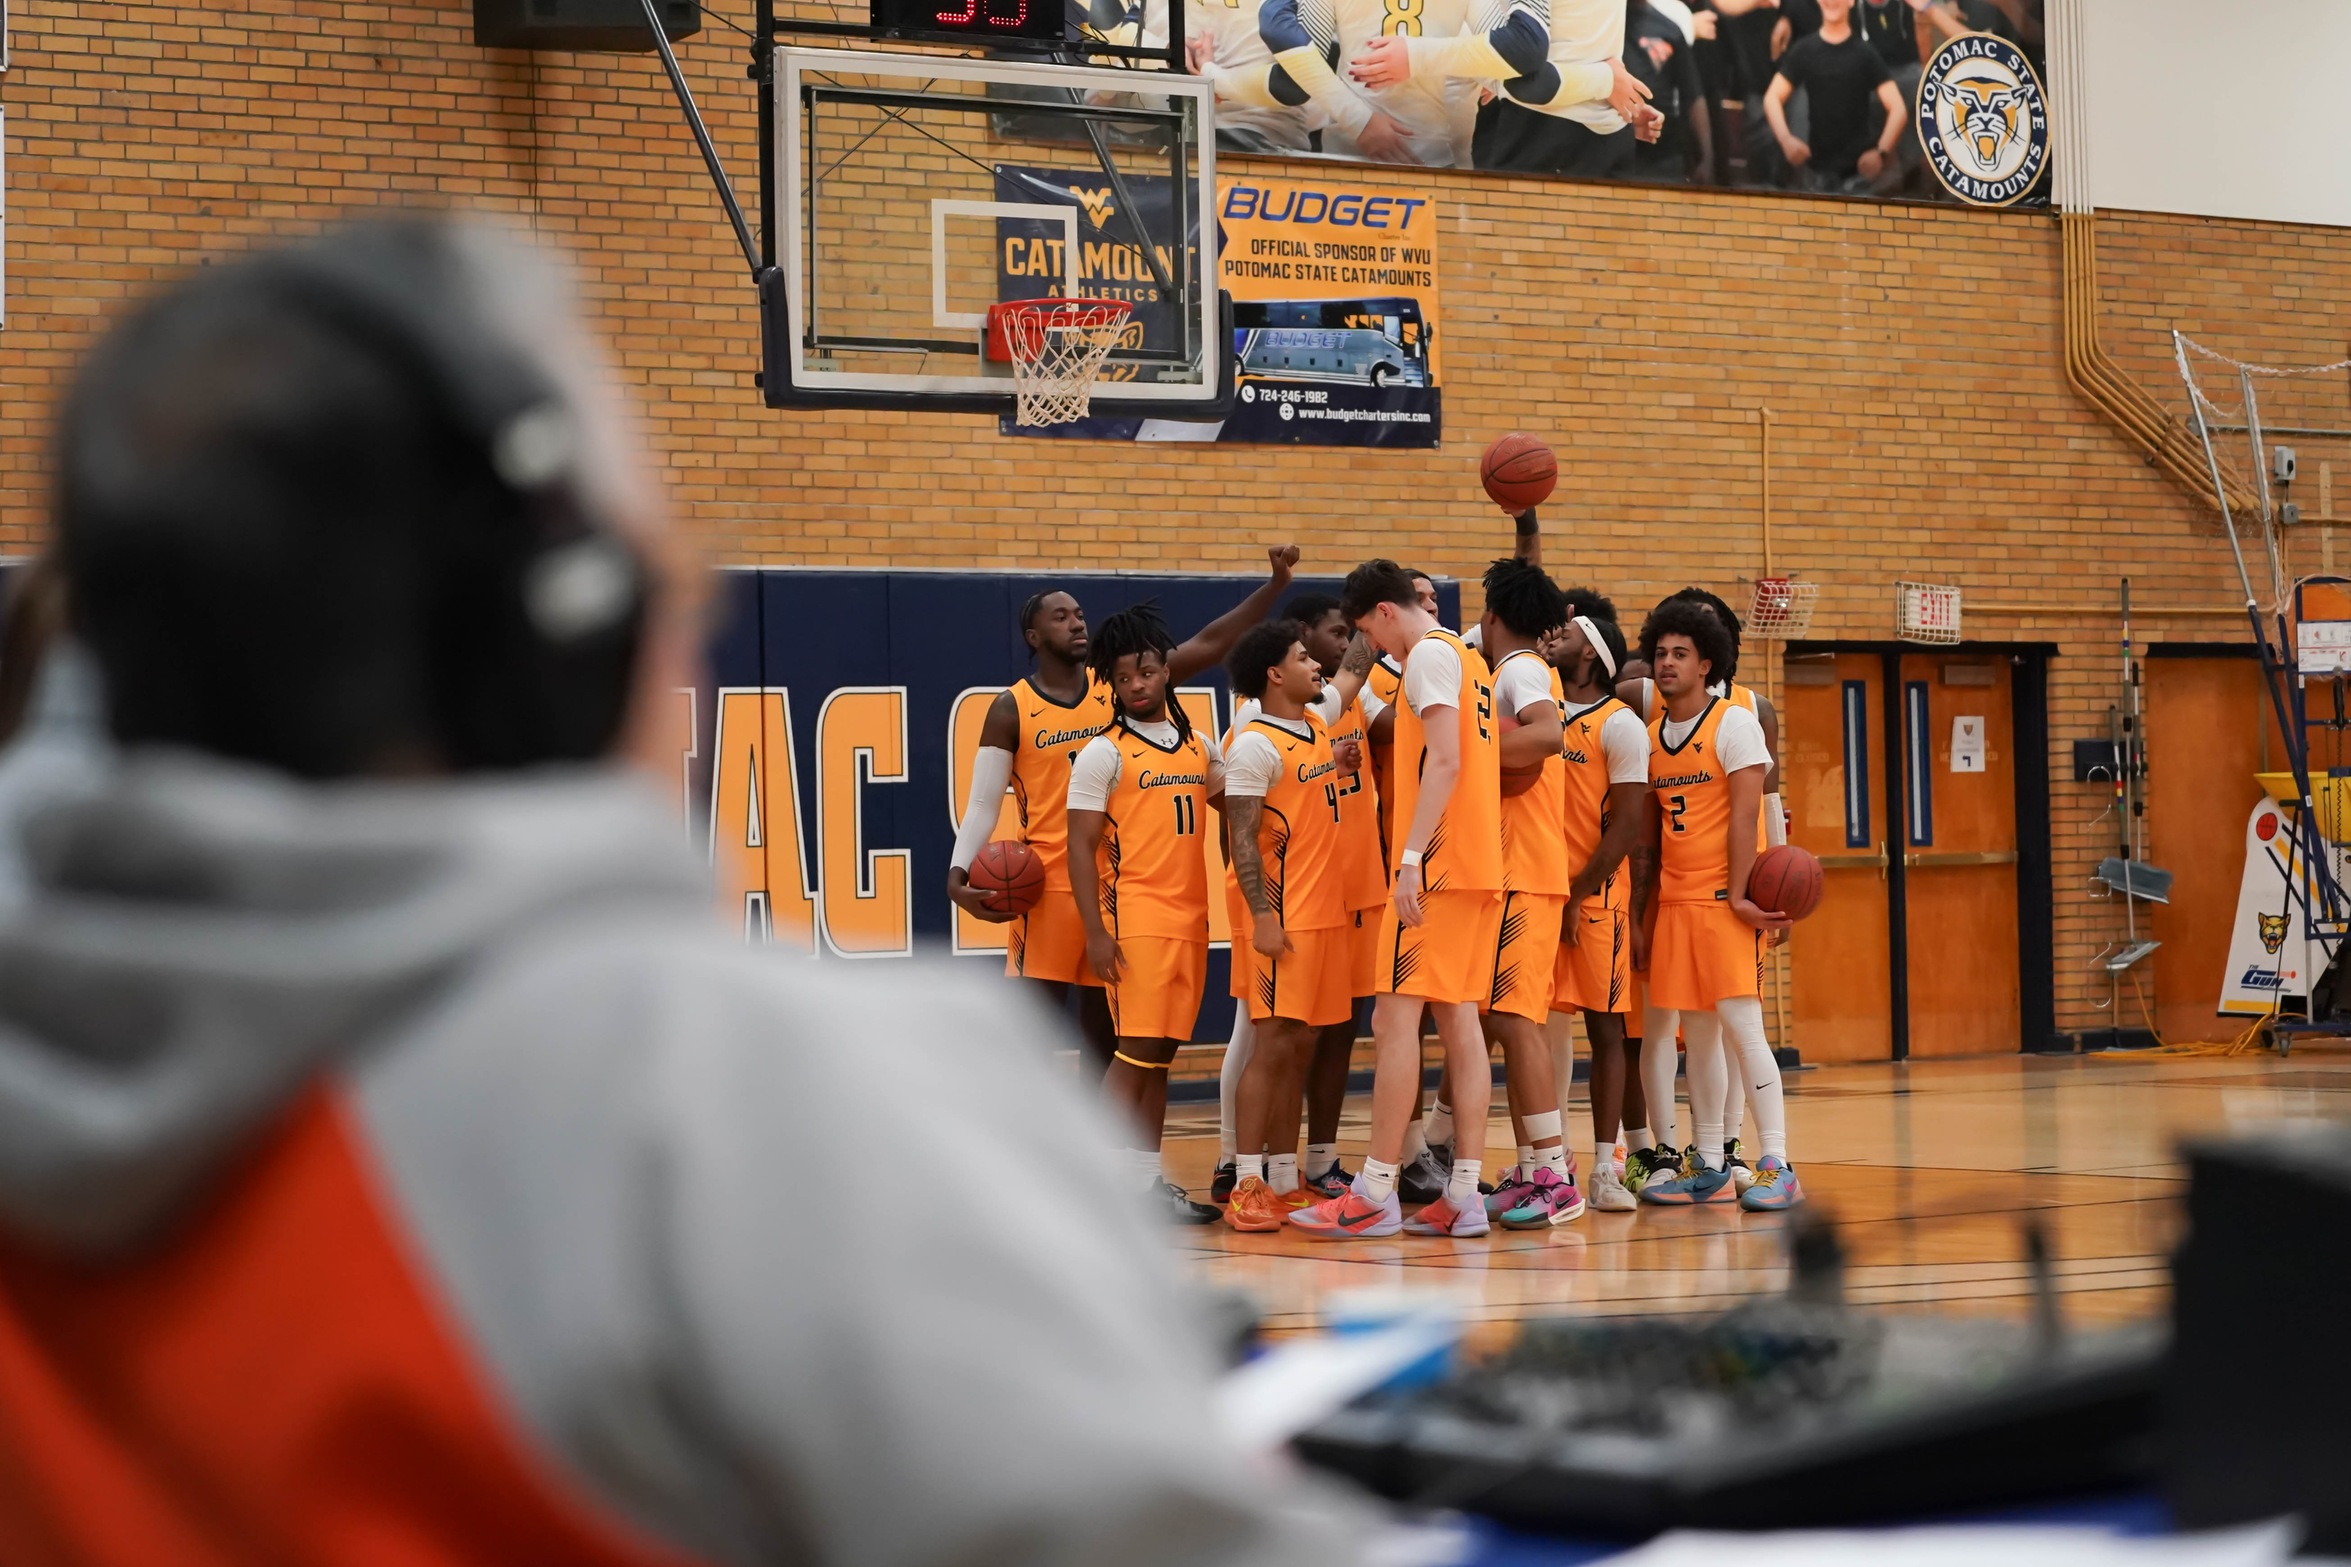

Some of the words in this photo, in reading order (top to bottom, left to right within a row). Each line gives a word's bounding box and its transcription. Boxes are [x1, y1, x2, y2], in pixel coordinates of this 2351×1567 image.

[1921, 39, 1997, 120] POTOMAC
[2008, 54, 2045, 131] STATE
[1929, 136, 2042, 200] CATAMOUNTS
[1223, 186, 1426, 230] BUDGET
[1251, 238, 1310, 258] OFFICIAL
[1314, 243, 1376, 262] SPONSOR
[1380, 246, 1396, 263] OF
[1401, 248, 1431, 265] WVU
[1225, 260, 1291, 279] POTOMAC
[1295, 264, 1338, 282] STATE
[1342, 267, 1432, 287] CATAMOUNTS
[1265, 331, 1352, 349] BUDGET
[1259, 389, 1328, 404] 724-246-1982
[1298, 408, 1431, 422] www.budgetchartersinc.com
[1920, 593, 1953, 626] EXIT
[1173, 794, 1195, 836] 11
[1325, 782, 1340, 823] 4
[1670, 795, 1686, 832] 2
